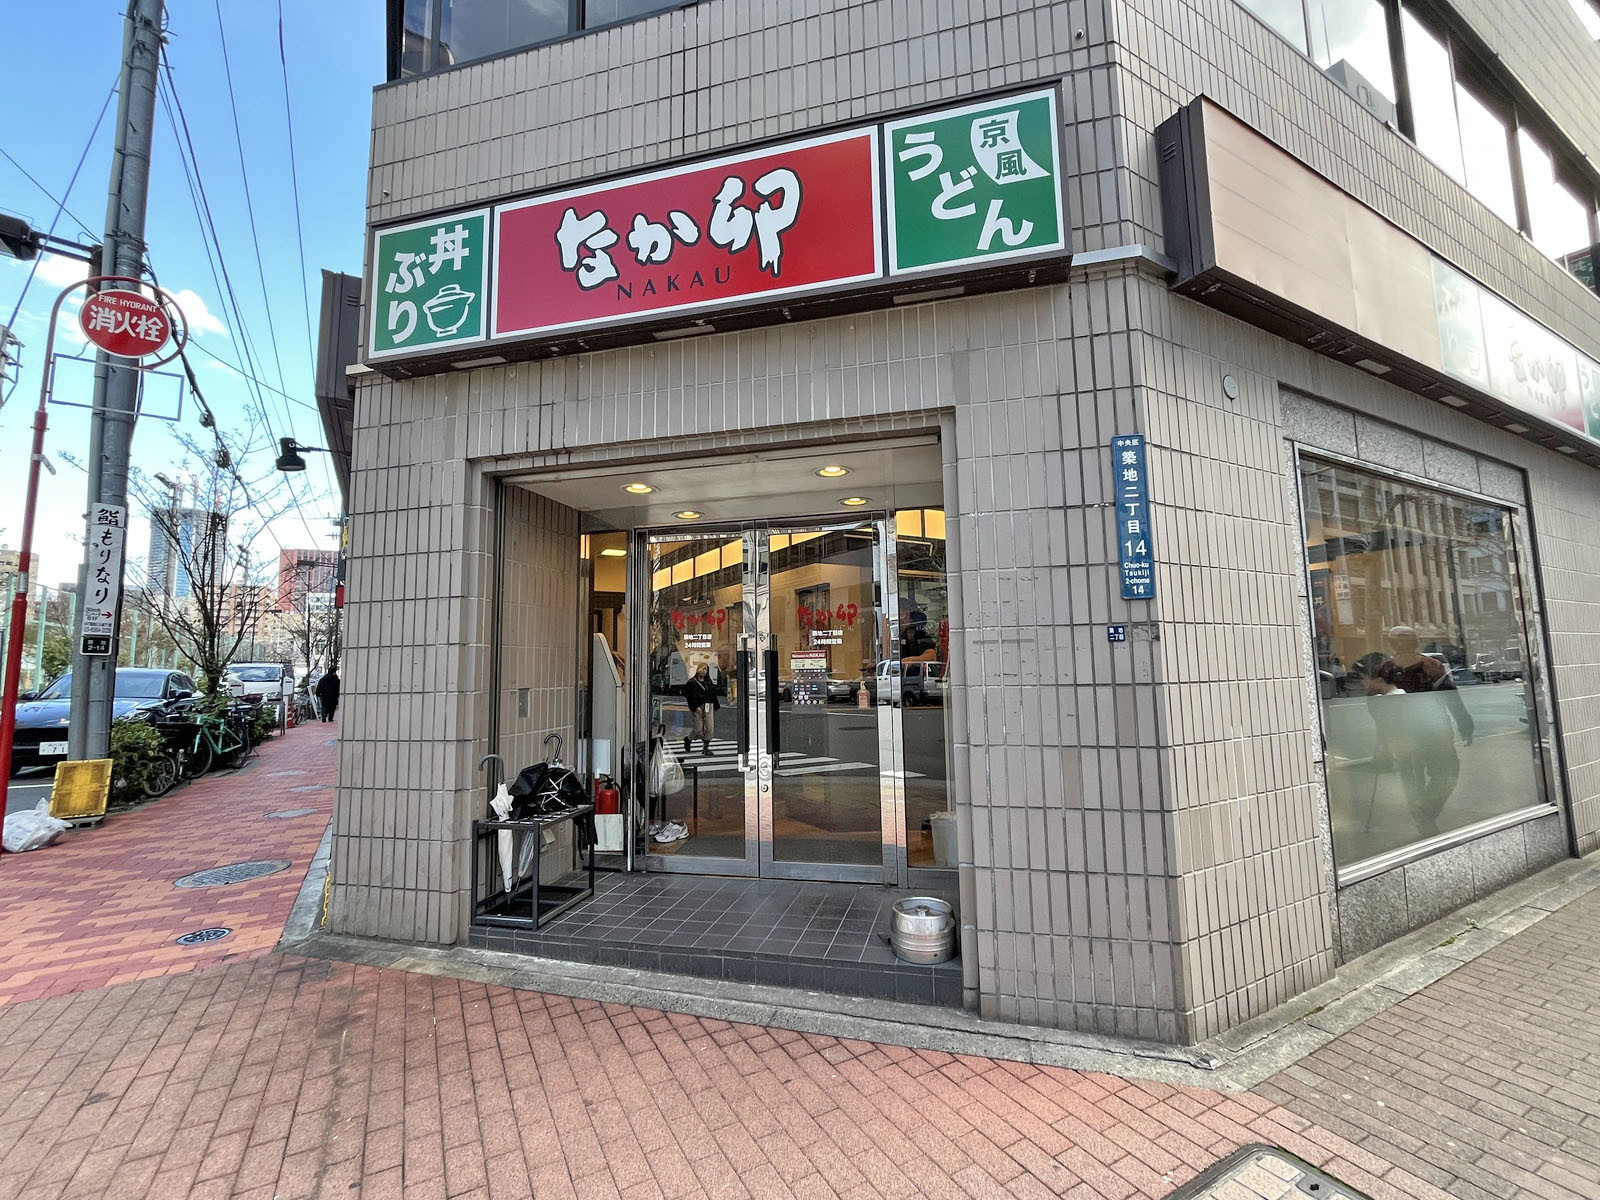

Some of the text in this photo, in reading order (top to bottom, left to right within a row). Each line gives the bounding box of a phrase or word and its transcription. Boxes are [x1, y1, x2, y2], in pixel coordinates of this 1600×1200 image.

[978, 119, 1028, 181] 京風
[898, 130, 1035, 251] うどん
[556, 167, 804, 292] なか卯
[617, 265, 731, 301] NAKAU
[98, 294, 157, 313] FIRE HYDRANT
[88, 304, 164, 343] 消火栓
[1117, 438, 1140, 447] 中央区
[1124, 539, 1148, 557] 14
[1123, 561, 1150, 569] Chuo-ku
[1124, 569, 1150, 577] Tsukiji
[1125, 577, 1151, 585] 2-chome
[1132, 585, 1145, 595] 14
